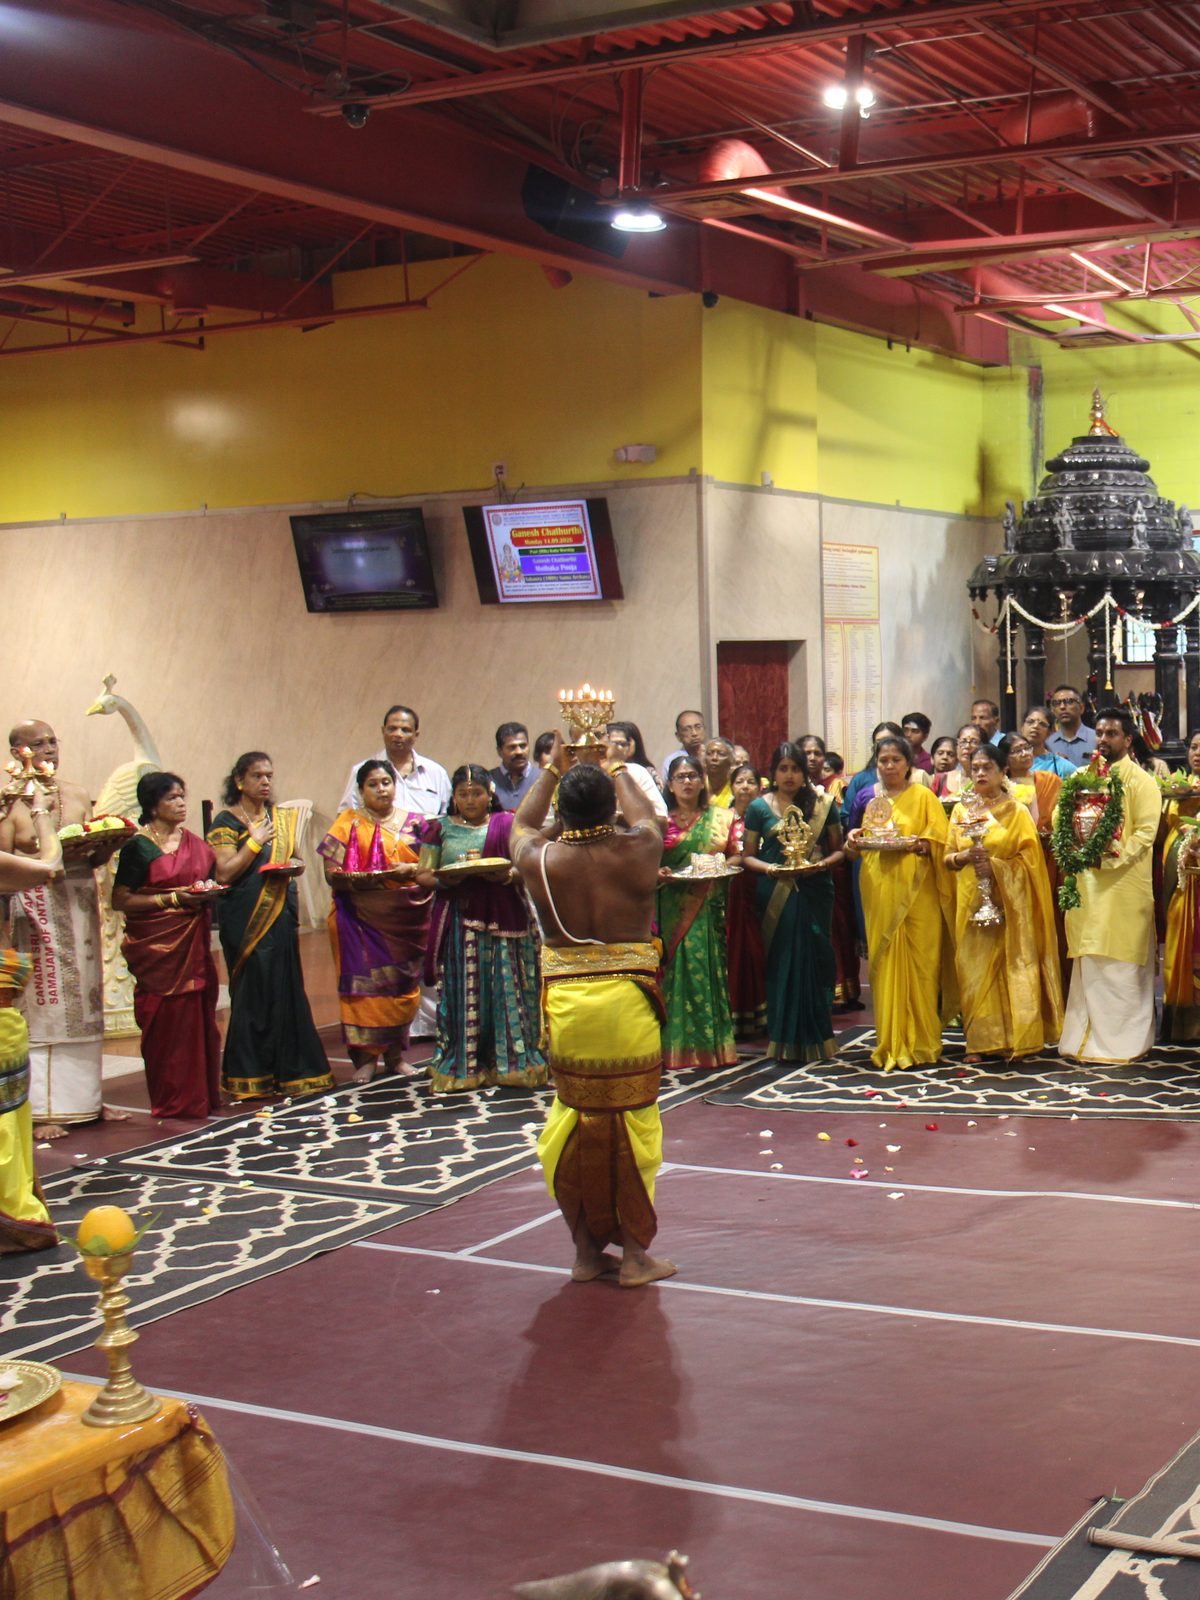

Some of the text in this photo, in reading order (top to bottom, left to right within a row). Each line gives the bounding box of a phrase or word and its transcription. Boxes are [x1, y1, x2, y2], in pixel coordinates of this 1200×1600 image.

[512, 528, 540, 538] Ganesh
[30, 933, 42, 954] SRI
[35, 885, 59, 1005] SAMAJAM OF ONTAR
[33, 957, 46, 1006] CANADA
